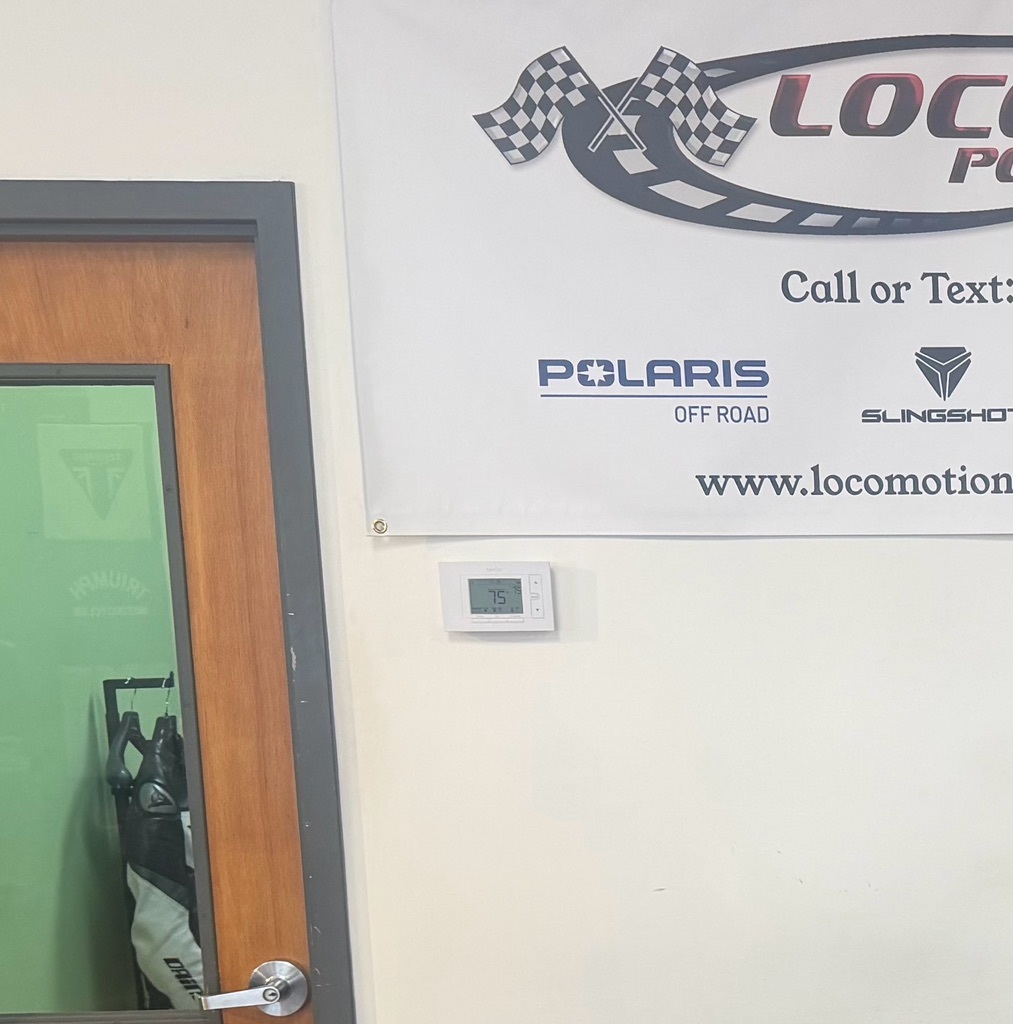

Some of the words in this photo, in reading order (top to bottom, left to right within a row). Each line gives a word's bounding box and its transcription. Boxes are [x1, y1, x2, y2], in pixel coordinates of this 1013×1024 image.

[780, 270, 860, 304] Call
[870, 282, 911, 304] or
[538, 358, 770, 388] POLARIS
[674, 405, 712, 423] OFF
[716, 405, 770, 423] ROAD
[163, 957, 204, 1001] DAIN
